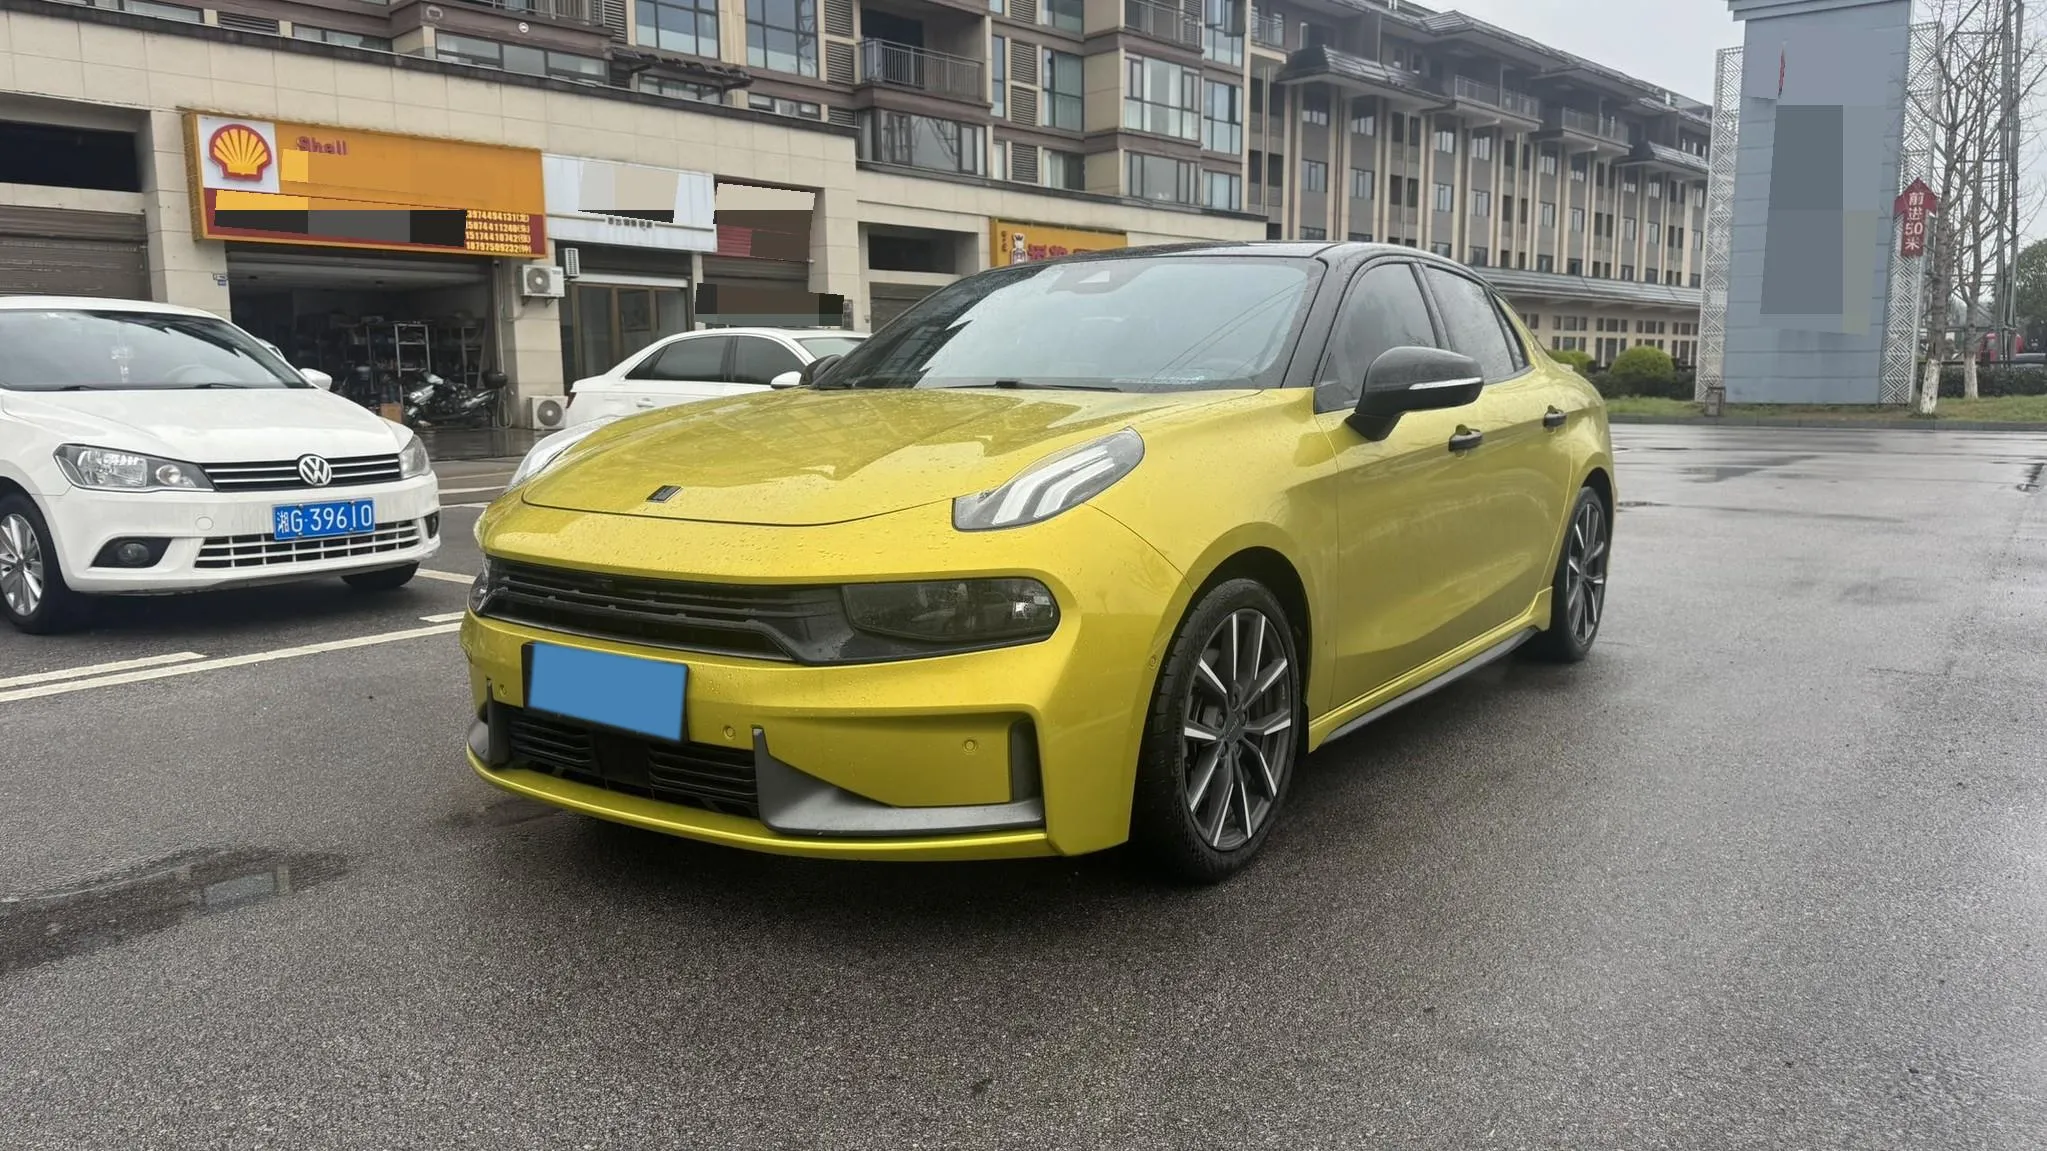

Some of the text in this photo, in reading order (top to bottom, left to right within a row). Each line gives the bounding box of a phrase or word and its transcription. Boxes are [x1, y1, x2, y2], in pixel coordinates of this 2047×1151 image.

[297, 136, 348, 156] Shell
[1905, 192, 1924, 250] 前进50米
[299, 456, 332, 486] VW
